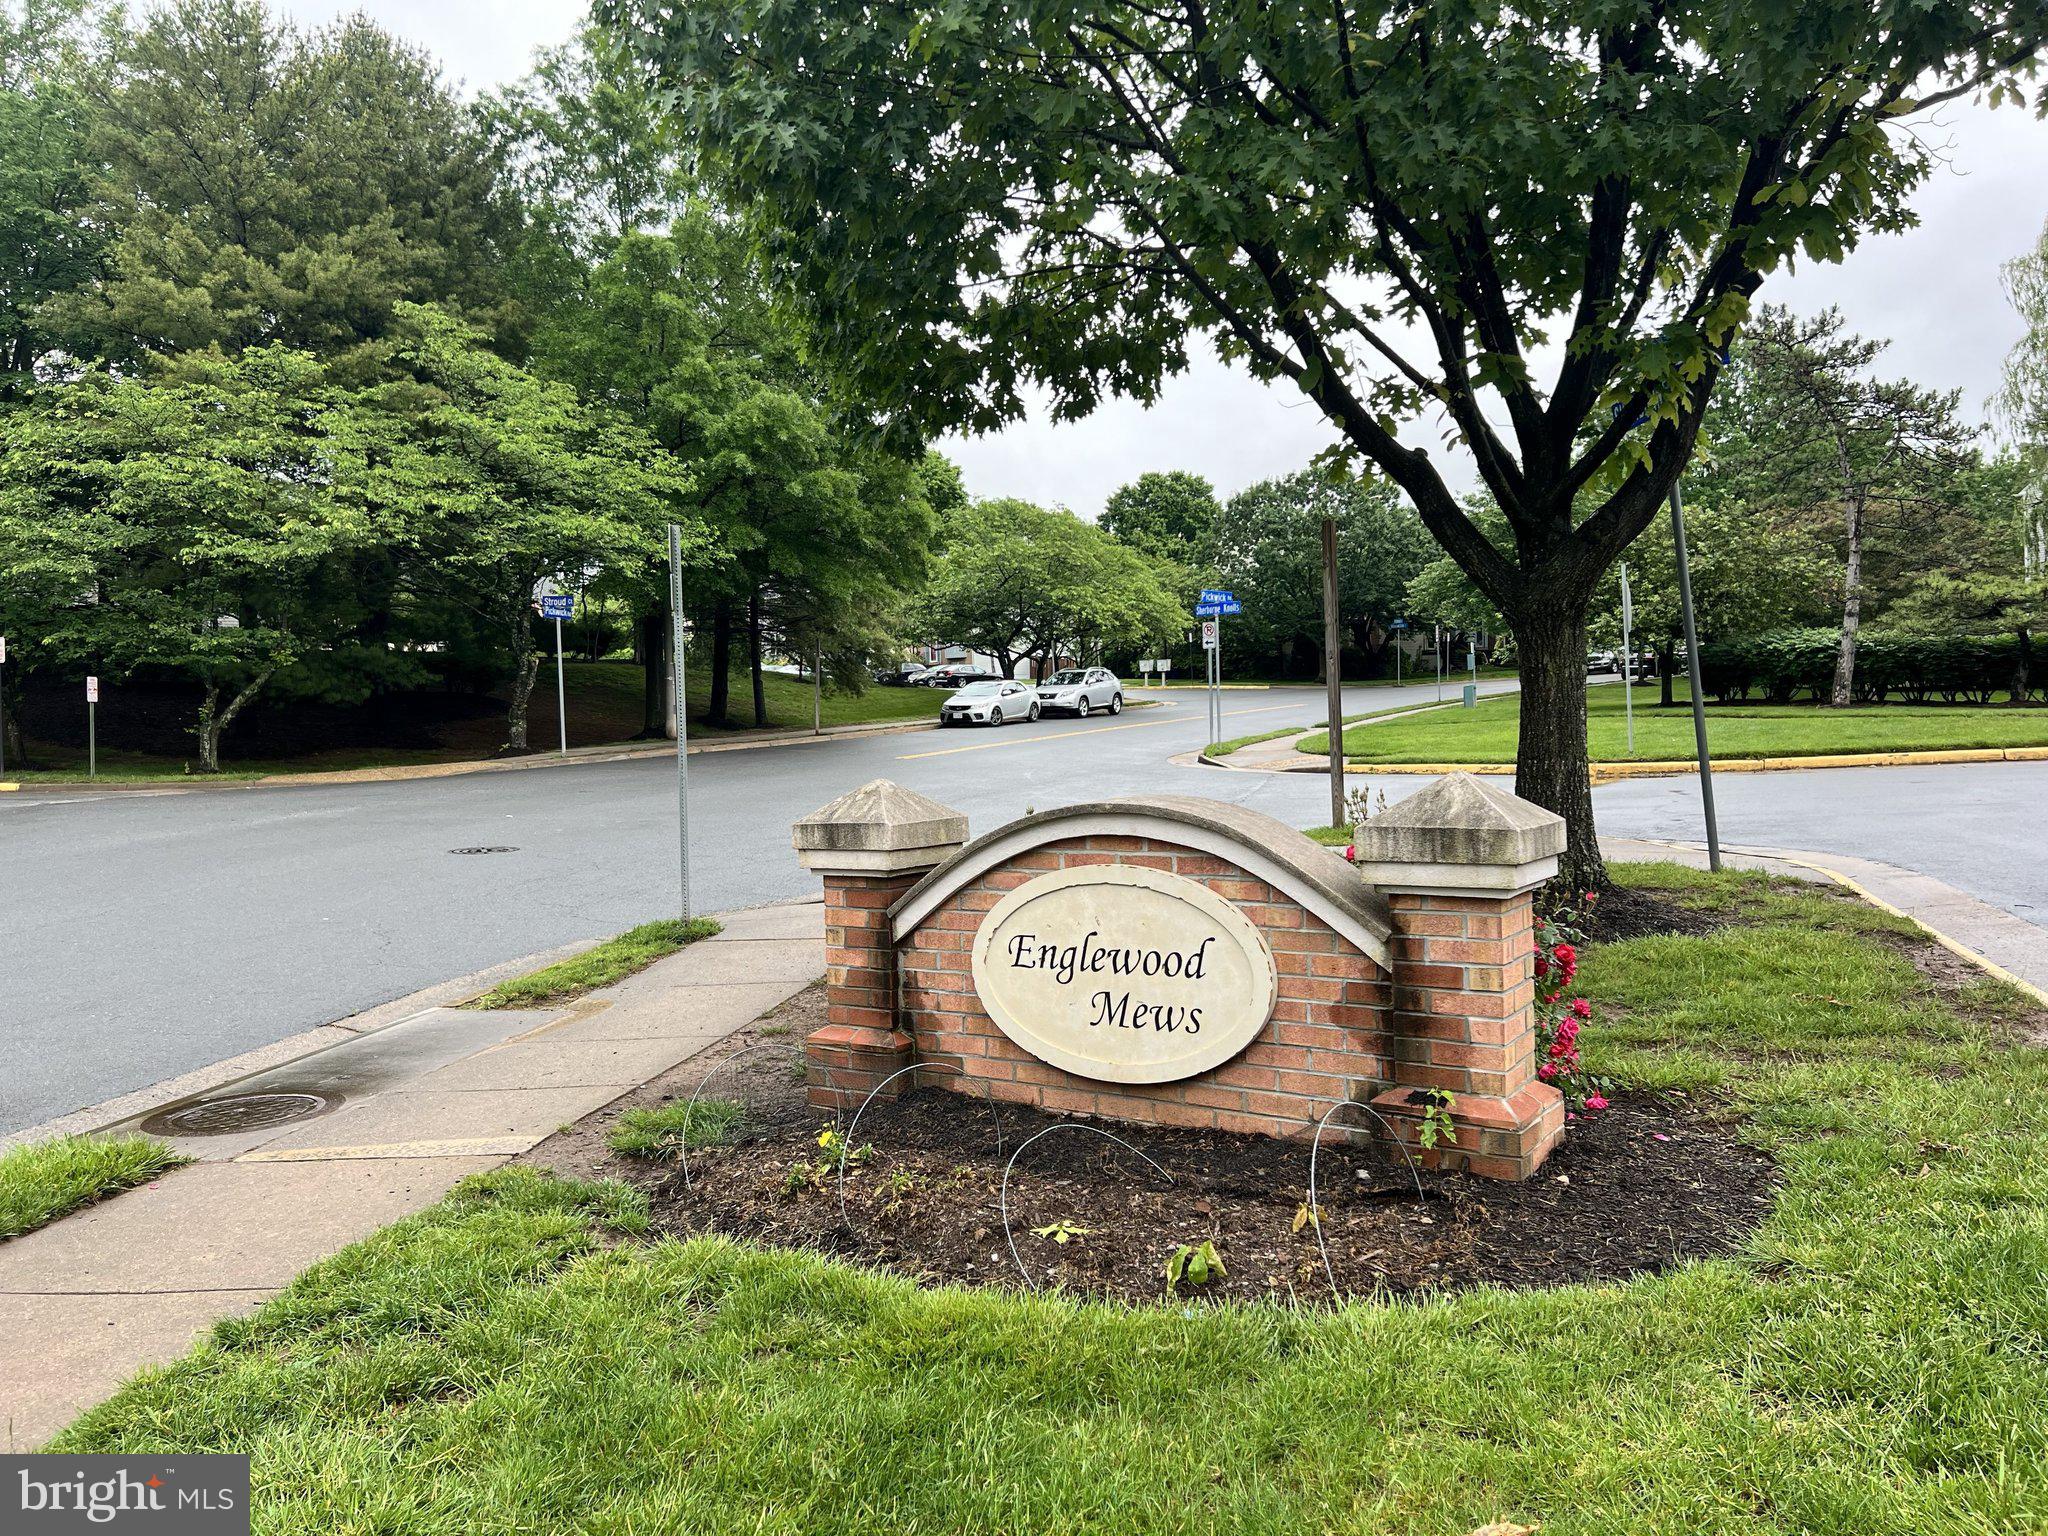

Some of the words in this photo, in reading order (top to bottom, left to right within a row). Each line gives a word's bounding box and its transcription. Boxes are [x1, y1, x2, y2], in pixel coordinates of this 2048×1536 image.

[544, 597, 567, 606] Stroud
[1201, 591, 1226, 602] Pickwick
[1008, 931, 1216, 985] Englewood
[1089, 991, 1203, 1034] Mews
